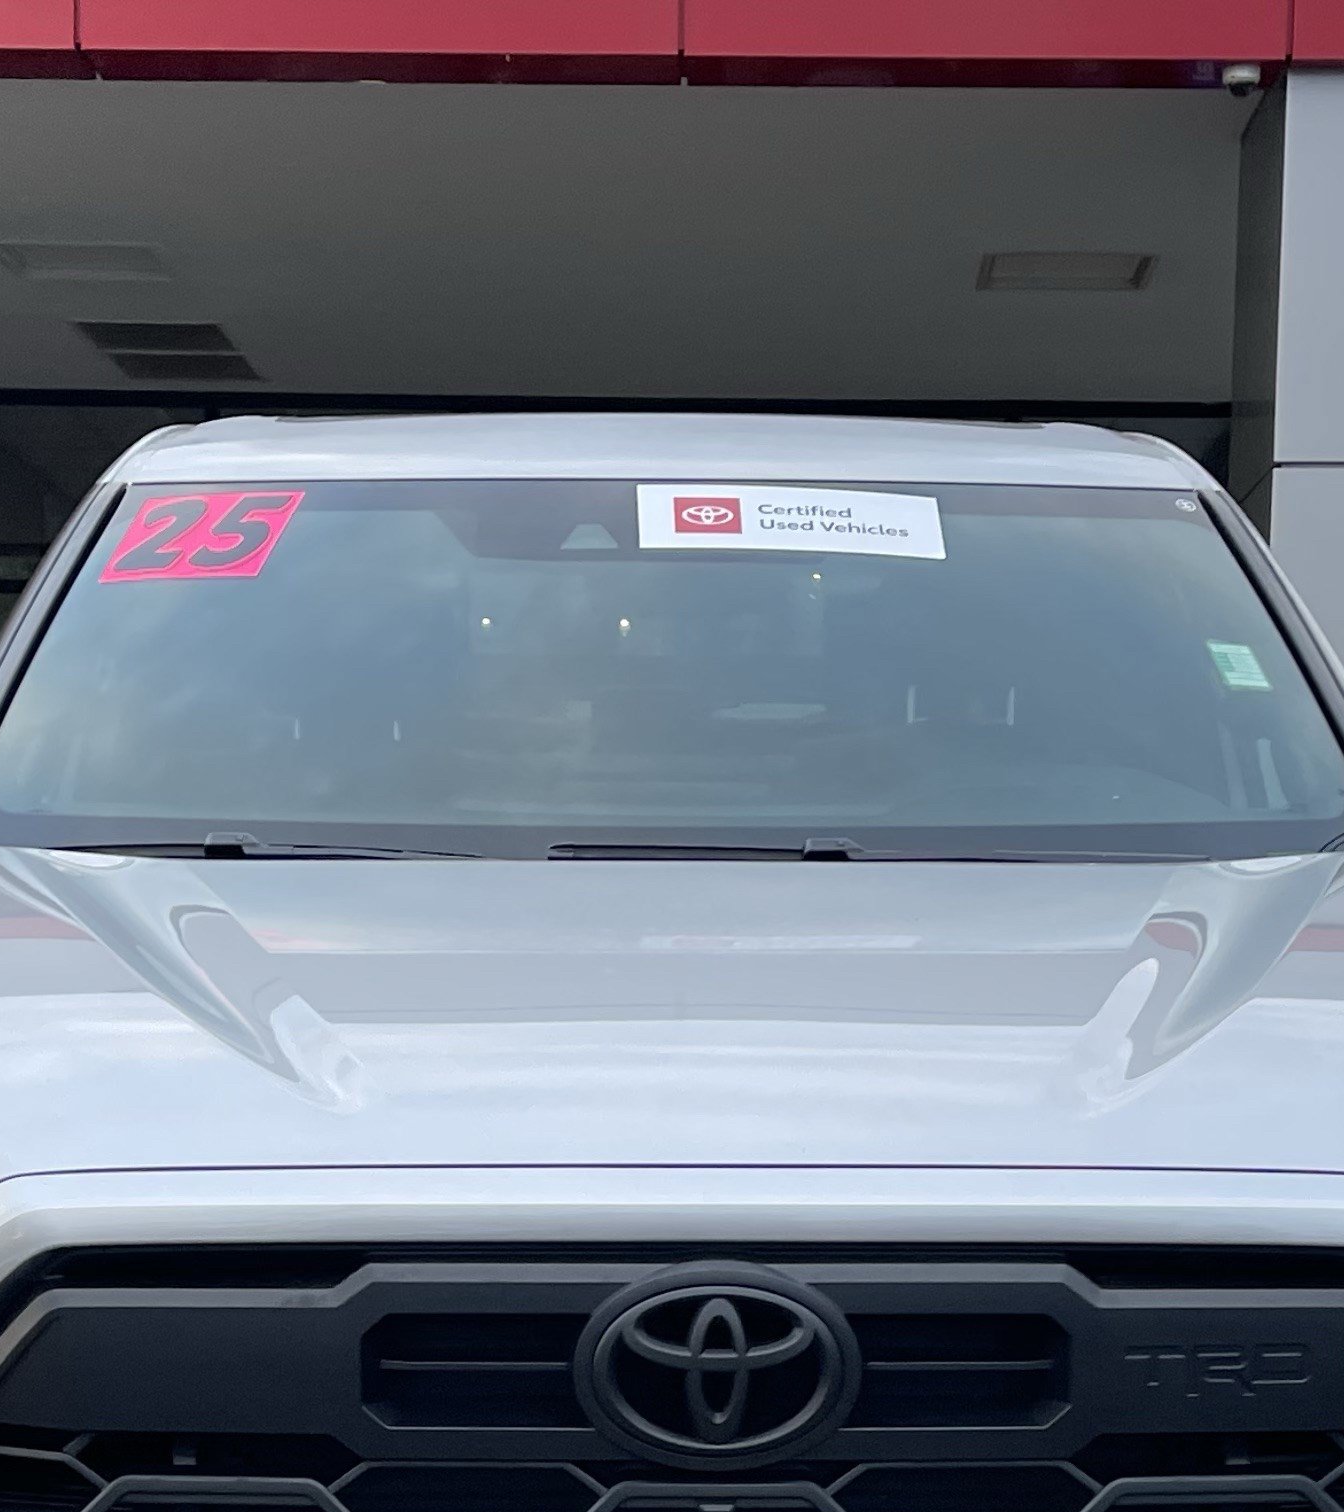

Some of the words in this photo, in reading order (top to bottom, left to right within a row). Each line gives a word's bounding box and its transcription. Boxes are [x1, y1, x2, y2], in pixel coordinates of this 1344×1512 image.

[757, 503, 852, 519] Certified
[759, 518, 815, 532] Used
[819, 521, 909, 538] Vehicles
[112, 495, 294, 571] 25
[1122, 1345, 1311, 1397] TRD
